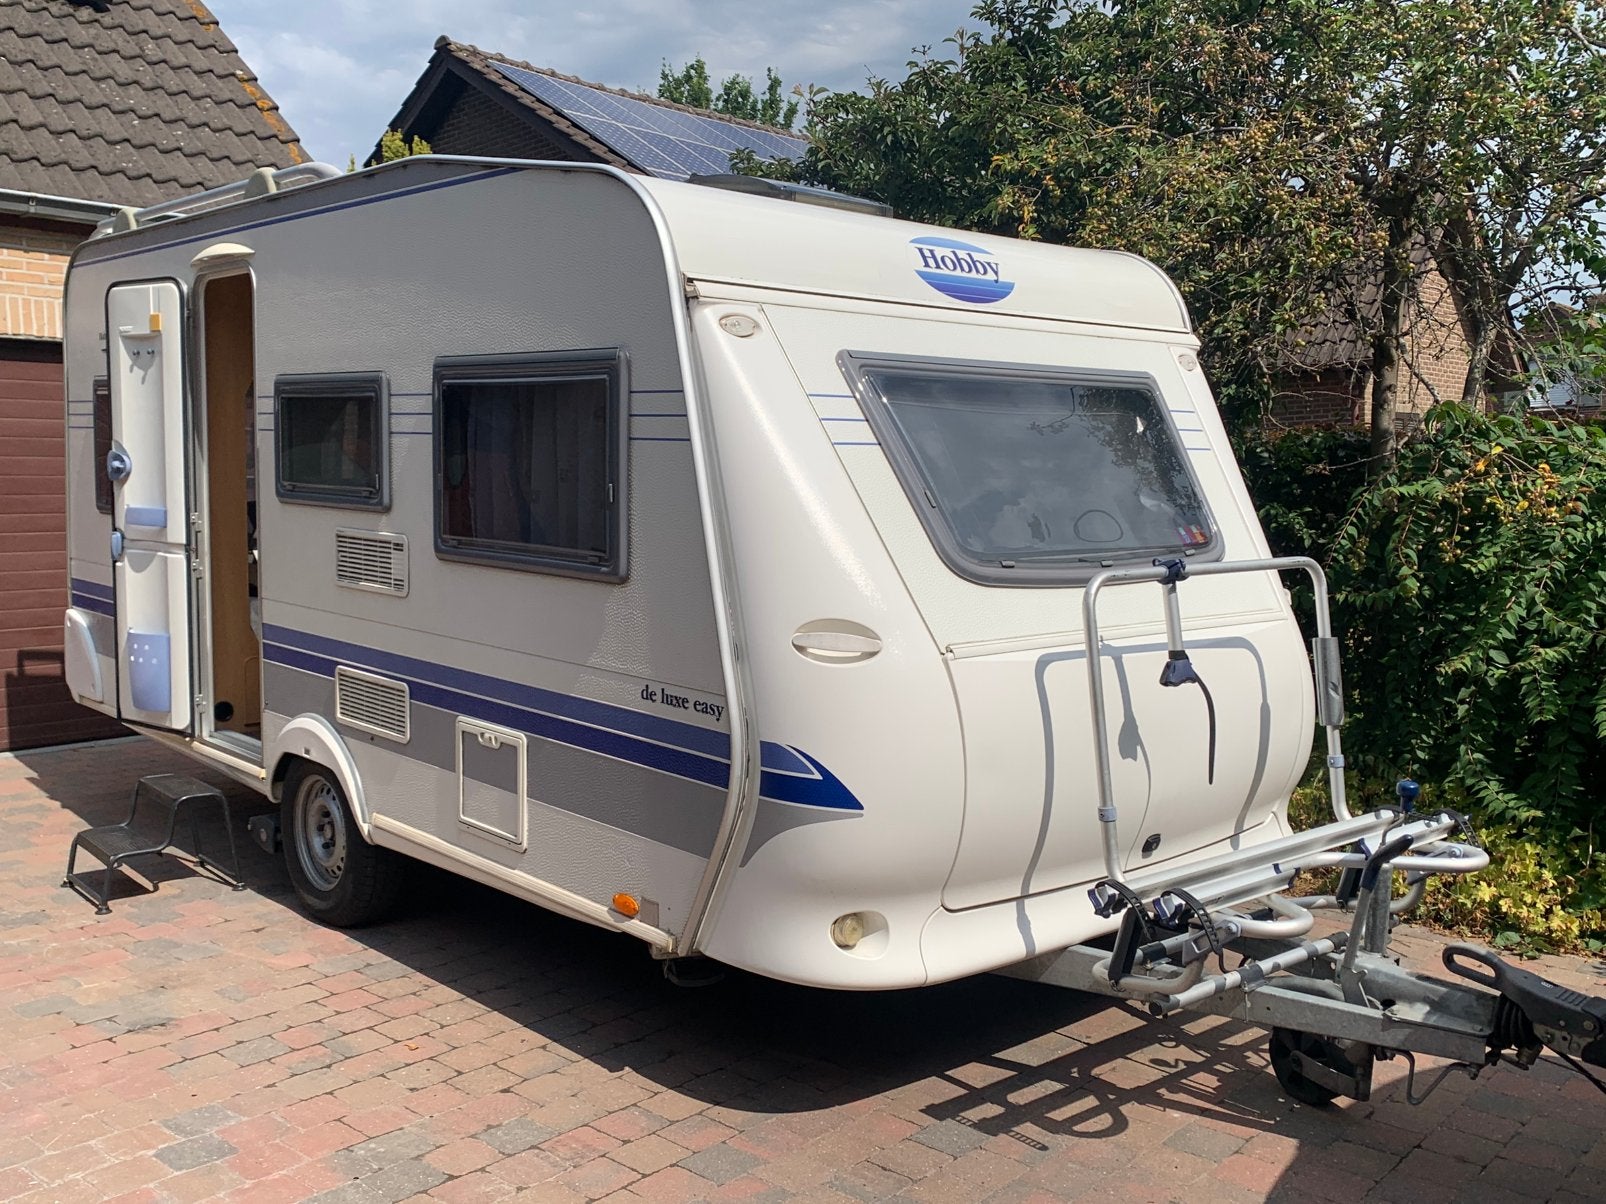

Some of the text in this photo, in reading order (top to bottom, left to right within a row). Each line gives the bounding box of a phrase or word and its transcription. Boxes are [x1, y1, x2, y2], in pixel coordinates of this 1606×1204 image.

[915, 246, 999, 284] Hobby
[641, 684, 725, 722] de luxe easy
